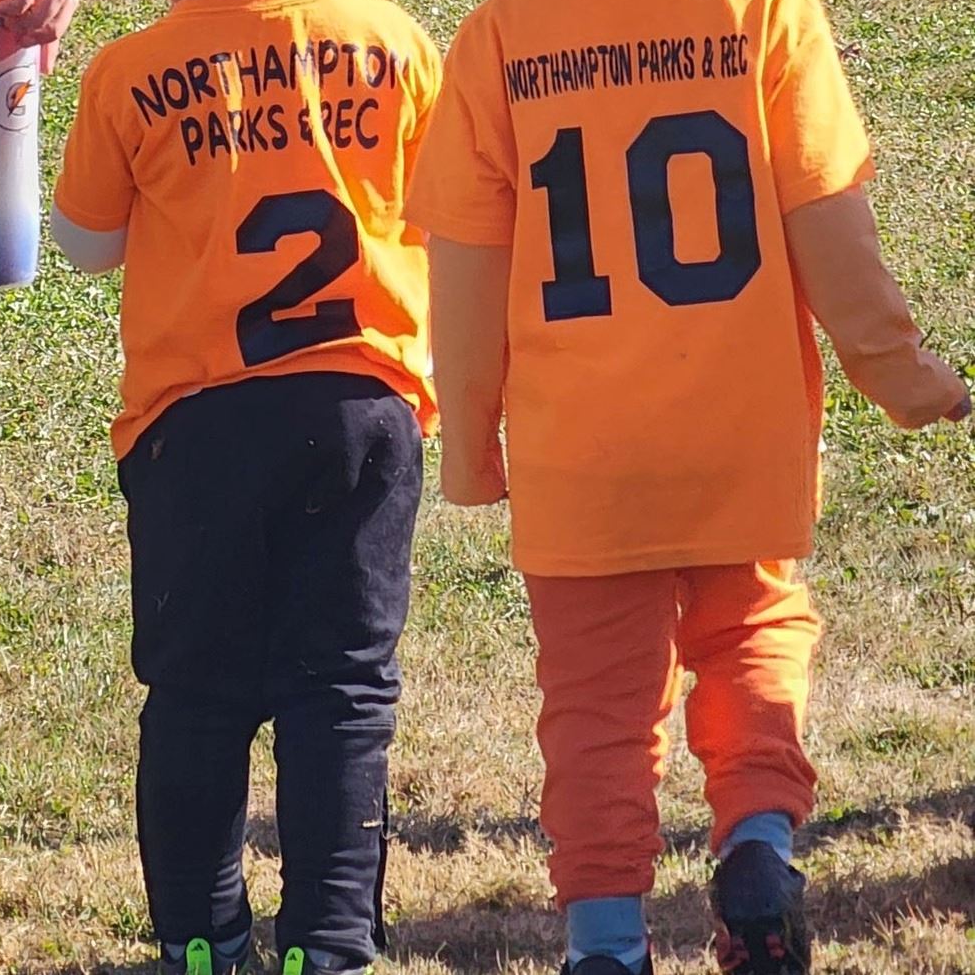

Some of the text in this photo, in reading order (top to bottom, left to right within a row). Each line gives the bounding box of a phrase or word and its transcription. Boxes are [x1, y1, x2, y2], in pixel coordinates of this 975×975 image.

[506, 33, 748, 104] NORTHAMPTON PARKS & REC
[181, 105, 288, 165] PARKS
[320, 98, 379, 149] REC
[236, 189, 363, 367] 2
[530, 110, 762, 322] 10
